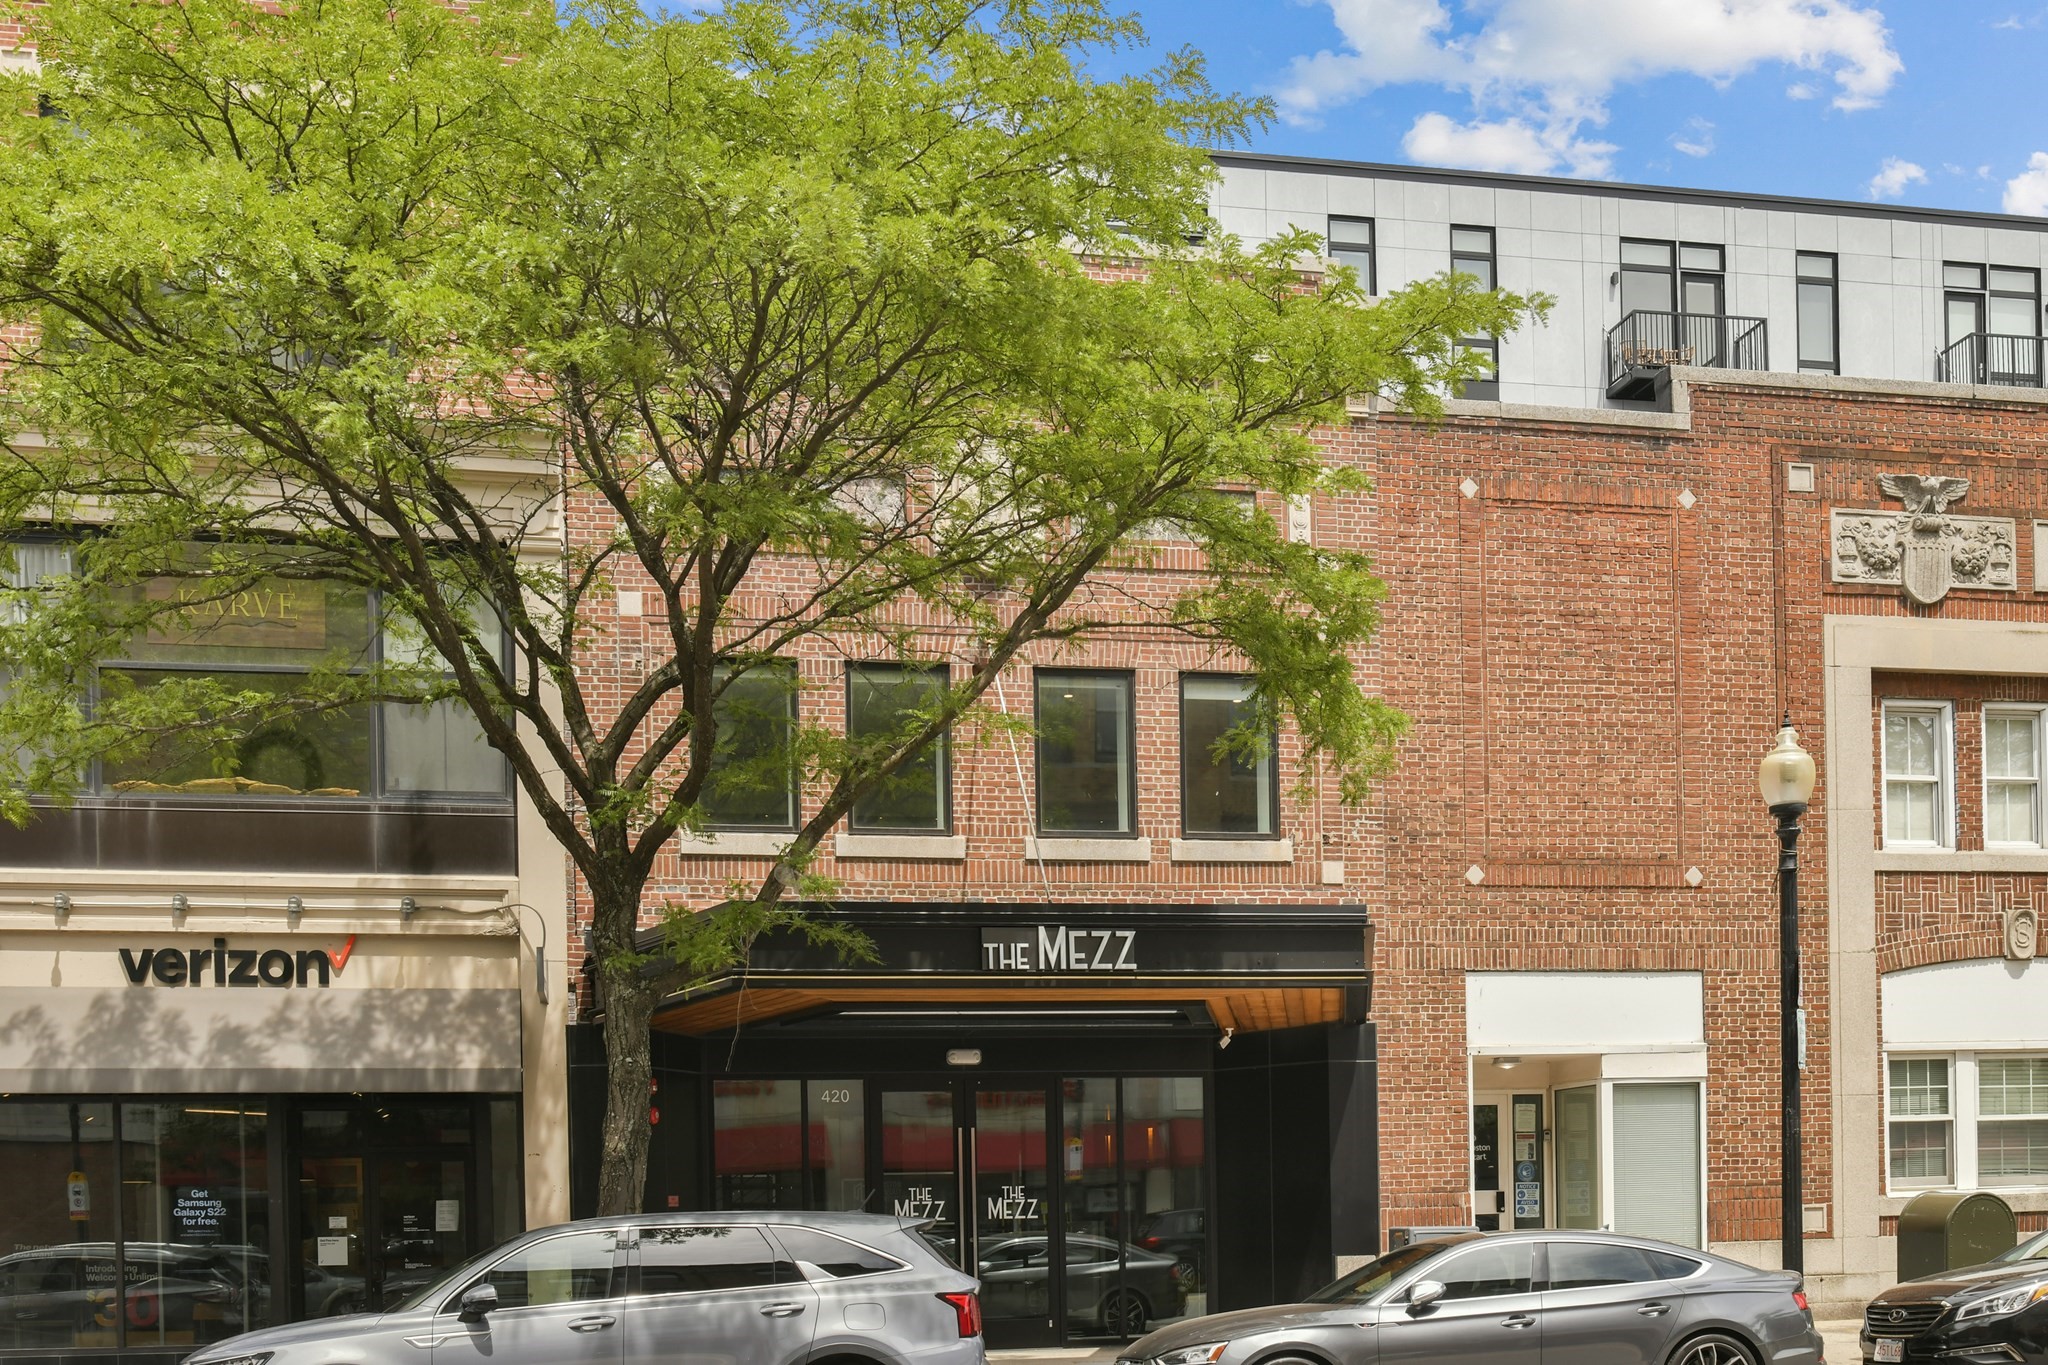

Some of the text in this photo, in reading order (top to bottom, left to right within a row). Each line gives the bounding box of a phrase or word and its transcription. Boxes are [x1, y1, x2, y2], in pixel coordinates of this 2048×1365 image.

[983, 926, 1137, 969] THE MEZZ
[118, 938, 330, 985] verizon
[821, 1090, 850, 1103] 420
[191, 1189, 209, 1198] Get
[908, 1187, 933, 1201] THE
[1001, 1186, 1025, 1199] THE
[177, 1198, 222, 1208] Samsung
[987, 1197, 1039, 1220] MEZZ
[173, 1207, 227, 1217] Galaxy S22
[894, 1199, 946, 1221] MEZZ
[182, 1217, 219, 1226] for free.
[85, 1264, 138, 1274] Introduing
[85, 1273, 128, 1282] Welcoe
